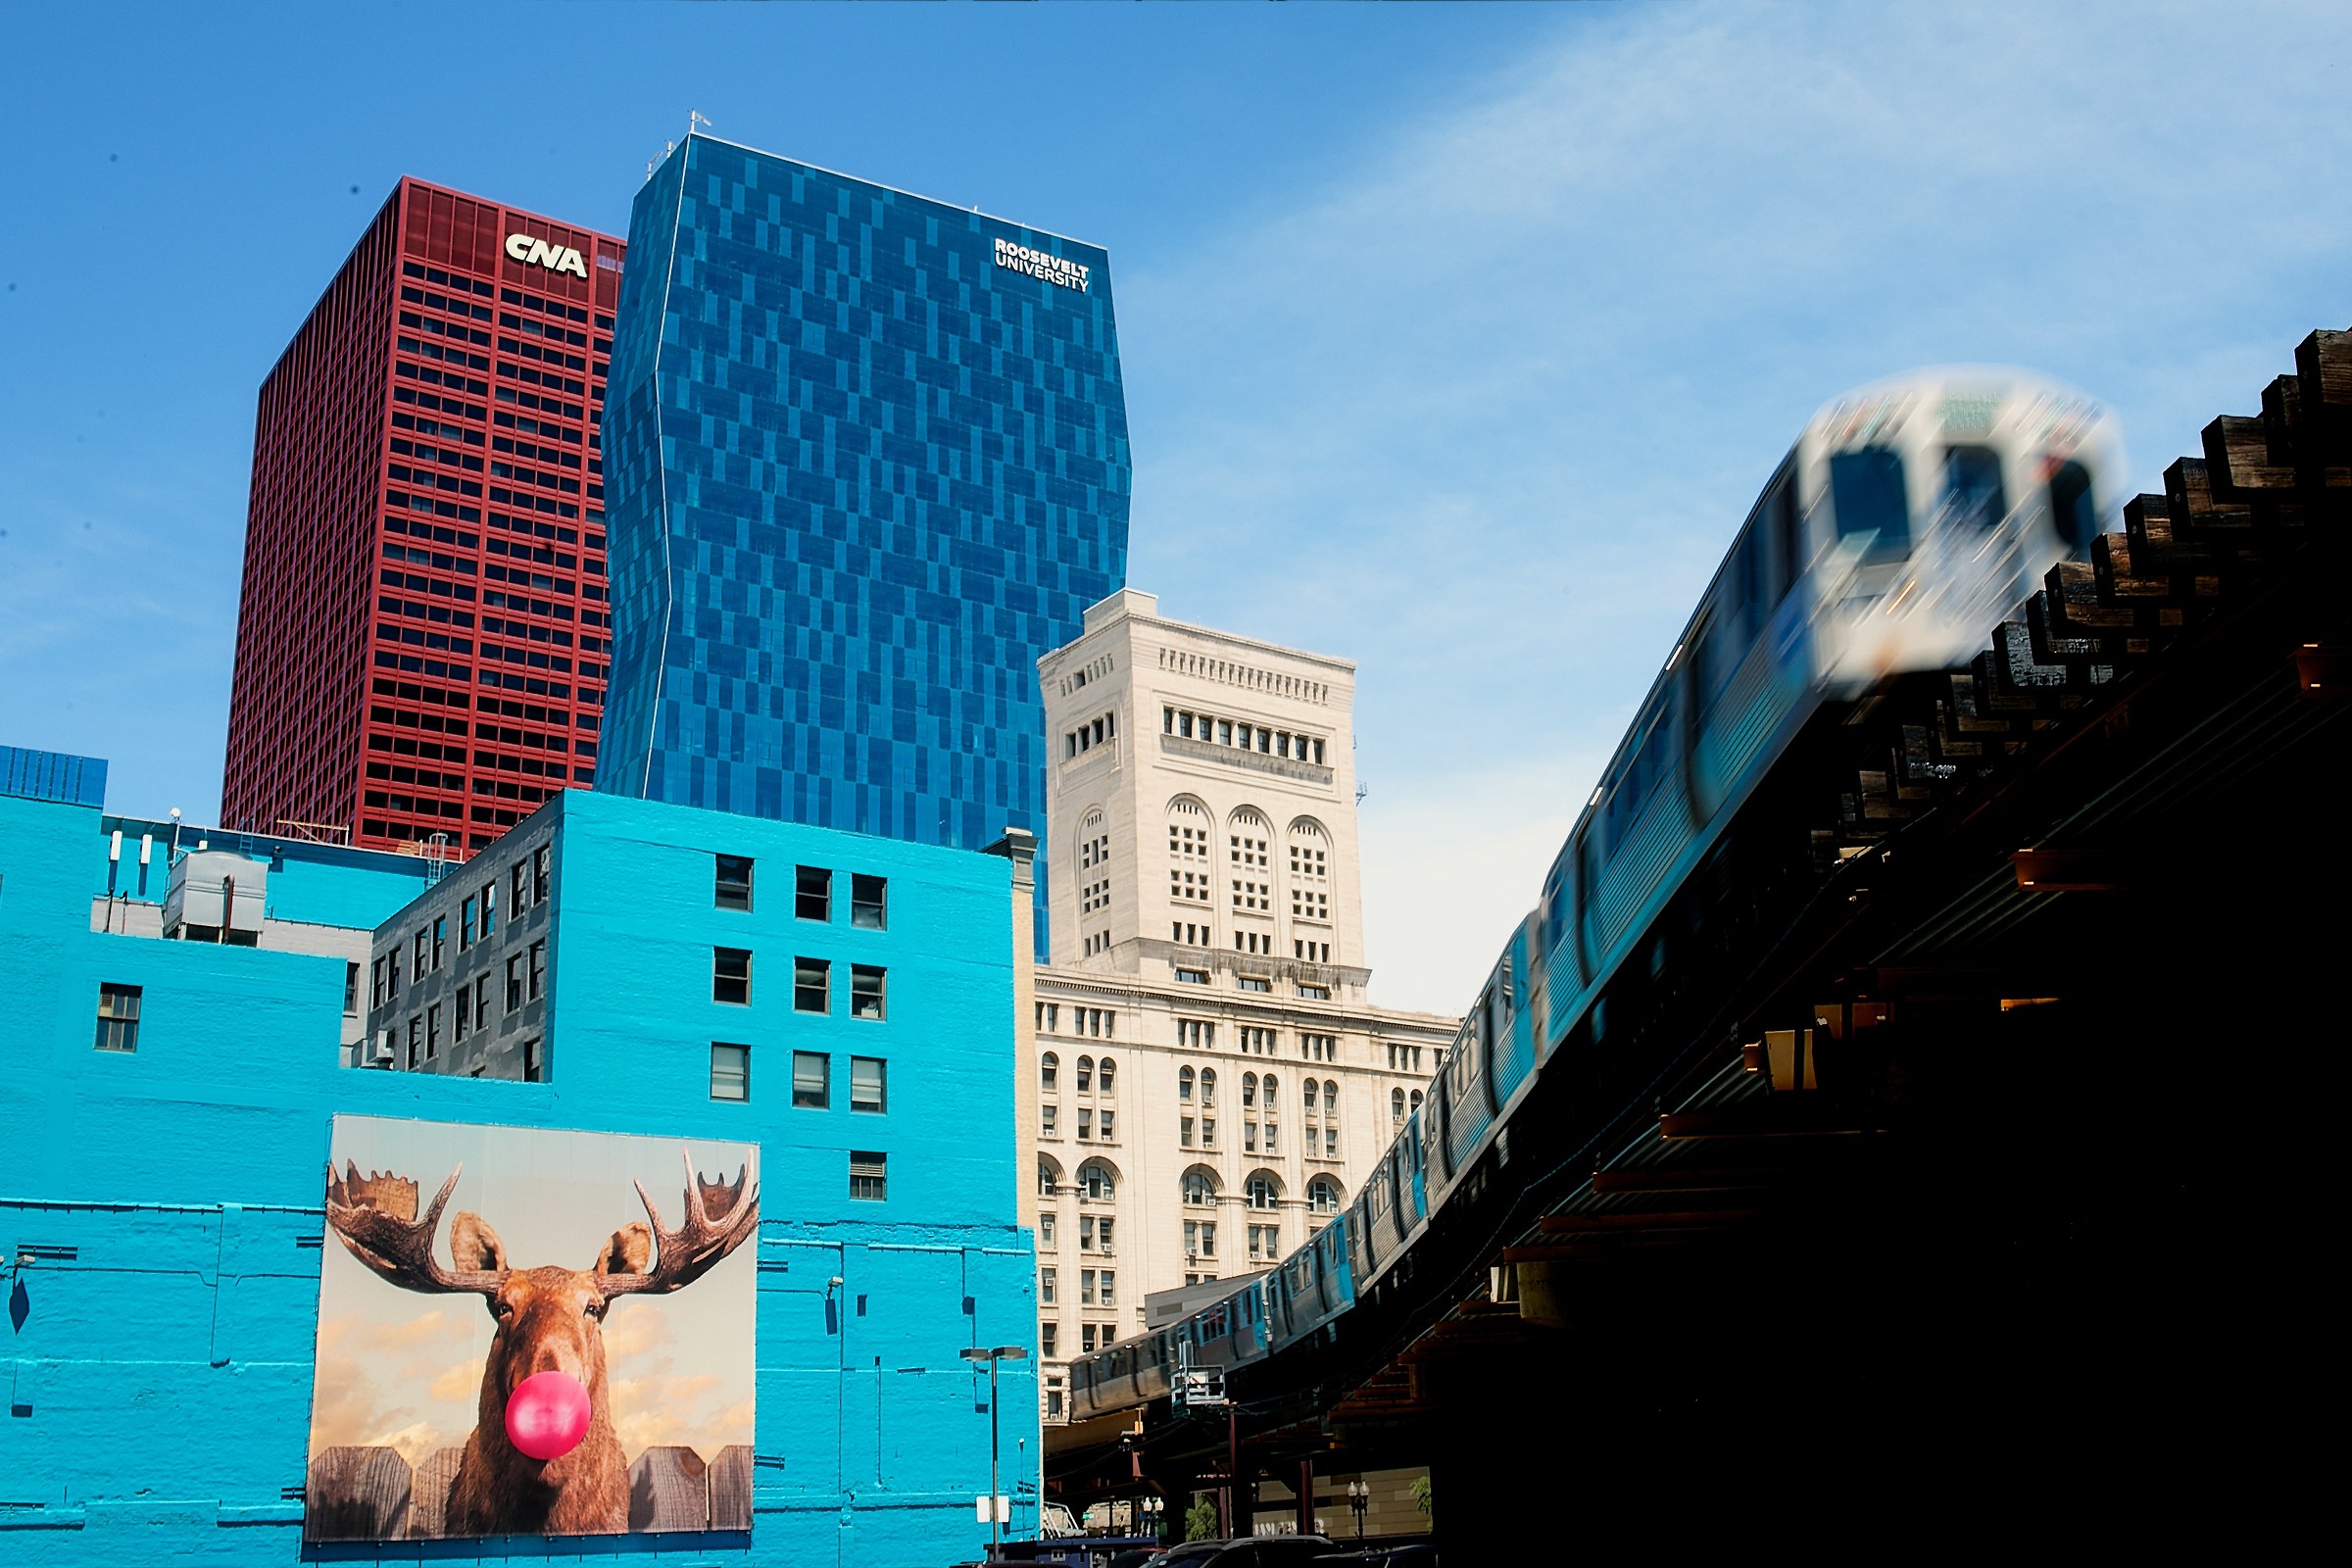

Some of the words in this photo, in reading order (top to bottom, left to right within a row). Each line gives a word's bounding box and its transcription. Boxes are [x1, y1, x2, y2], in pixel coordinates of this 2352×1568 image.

[505, 233, 588, 278] CNA
[995, 237, 1090, 279] ROOSEVELT
[995, 252, 1089, 293] UNIVERSITY
